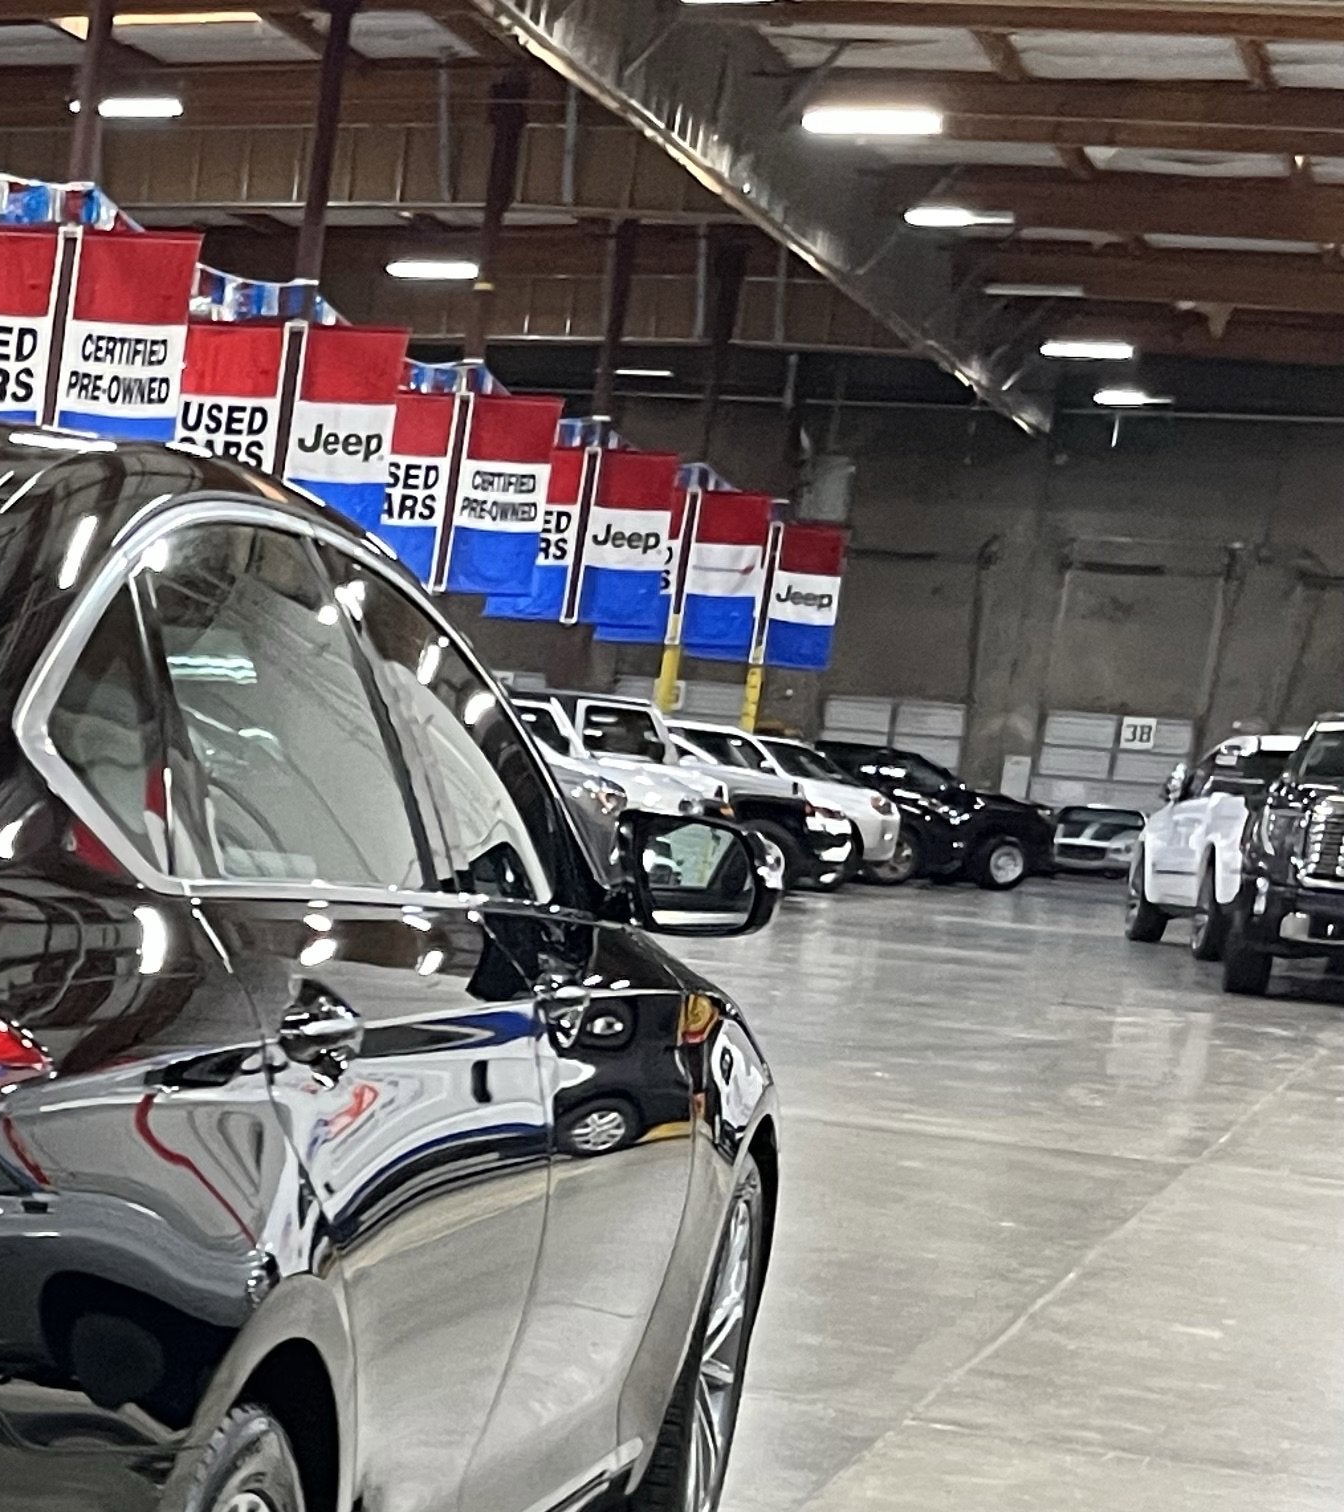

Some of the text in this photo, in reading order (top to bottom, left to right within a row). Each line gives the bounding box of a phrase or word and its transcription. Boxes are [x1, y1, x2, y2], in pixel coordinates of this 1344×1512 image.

[81, 333, 168, 367] CERTIFIED
[66, 371, 171, 405] PRE-OWNED
[181, 401, 269, 436] USED
[297, 423, 383, 462] Jeep
[388, 462, 440, 491] SED
[382, 493, 437, 520] ARS
[542, 510, 572, 534] ED
[539, 537, 568, 560] RS
[592, 523, 661, 555] Jeep
[775, 584, 833, 611] Jeep
[1124, 724, 1153, 743] 38
